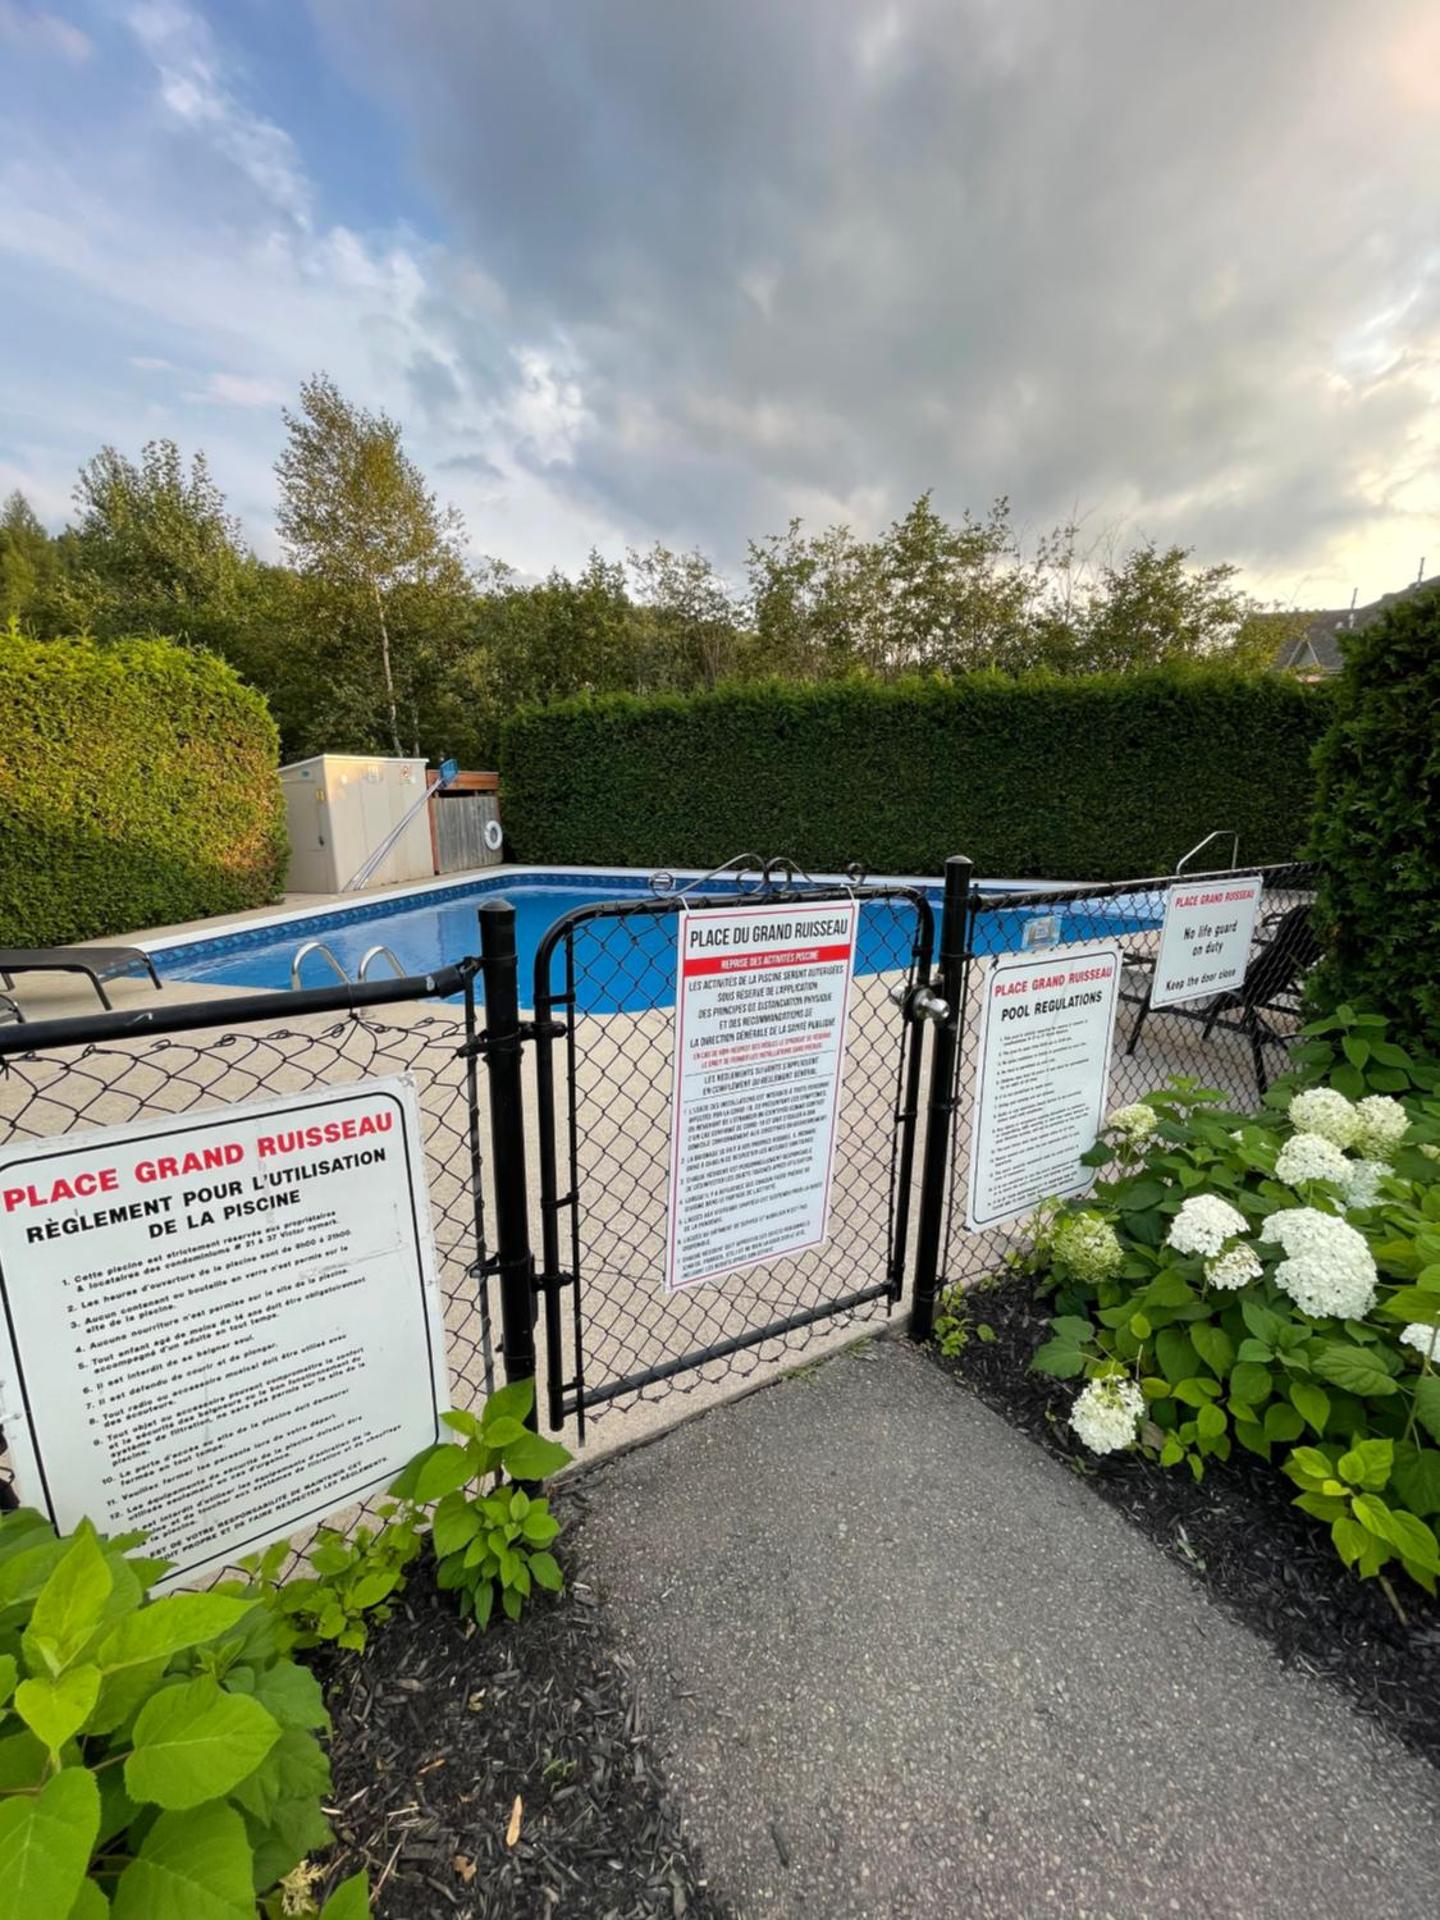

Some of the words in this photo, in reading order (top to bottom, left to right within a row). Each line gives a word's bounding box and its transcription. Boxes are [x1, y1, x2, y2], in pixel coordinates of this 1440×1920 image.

[1176, 896, 1199, 908] PLACE
[1200, 893, 1223, 905] GRAND
[1226, 890, 1255, 902] RUISSEAU
[690, 928, 730, 948] PLACE
[733, 927, 750, 945] DU
[753, 923, 792, 942] GRAND
[795, 919, 848, 939] RUISSEAU
[1184, 928, 1196, 940] No
[1198, 924, 1213, 938] life
[1215, 920, 1238, 938] guard
[1192, 946, 1203, 956] on
[1205, 942, 1223, 955] duty
[689, 981, 702, 992] LES
[703, 976, 737, 990] ACTIVITÉS
[739, 975, 747, 986] DE
[749, 975, 757, 985] LA
[758, 972, 782, 984] PISCINE
[995, 981, 1028, 997] PLACE
[1032, 975, 1065, 991] GRAND
[1069, 967, 1113, 984] RUISSEAU
[1166, 980, 1185, 991] Keep
[1187, 977, 1199, 987] the
[1201, 973, 1217, 984] door
[1219, 969, 1236, 980] close
[718, 992, 735, 1003] SOUS
[766, 986, 775, 996] DE
[698, 1008, 711, 1019] DES
[713, 1003, 746, 1017] PRINCIPES
[1002, 1005, 1030, 1022] POOL
[1034, 992, 1103, 1015] REGULATIONS
[719, 1020, 727, 1031] ET
[729, 1017, 741, 1029] DES
[690, 1038, 699, 1048] LA
[700, 1032, 735, 1046] DIRECTION
[3, 1169, 119, 1212] PLACE
[134, 1144, 244, 1184] GRAND
[257, 1112, 393, 1158] RUISSEAU
[26, 1196, 173, 1244] RÈGLEMENT
[183, 1181, 243, 1208] POUR
[253, 1148, 386, 1192] L'UTILISATION
[149, 1219, 178, 1239] DE
[188, 1209, 215, 1229] LA
[224, 1190, 301, 1221] PISCINE
[73, 1271, 103, 1283] Cette
[106, 1260, 143, 1276] piscine
[147, 1254, 163, 1264] est
[142, 1265, 161, 1275] des
[80, 1299, 100, 1309] Les
[102, 1288, 138, 1303] heures
[198, 1268, 210, 1277] de
[84, 1311, 117, 1325] Aucun
[120, 1295, 169, 1315] contenant
[172, 1291, 185, 1300] ou
[108, 1316, 122, 1328] de
[89, 1333, 127, 1350] Aucune
